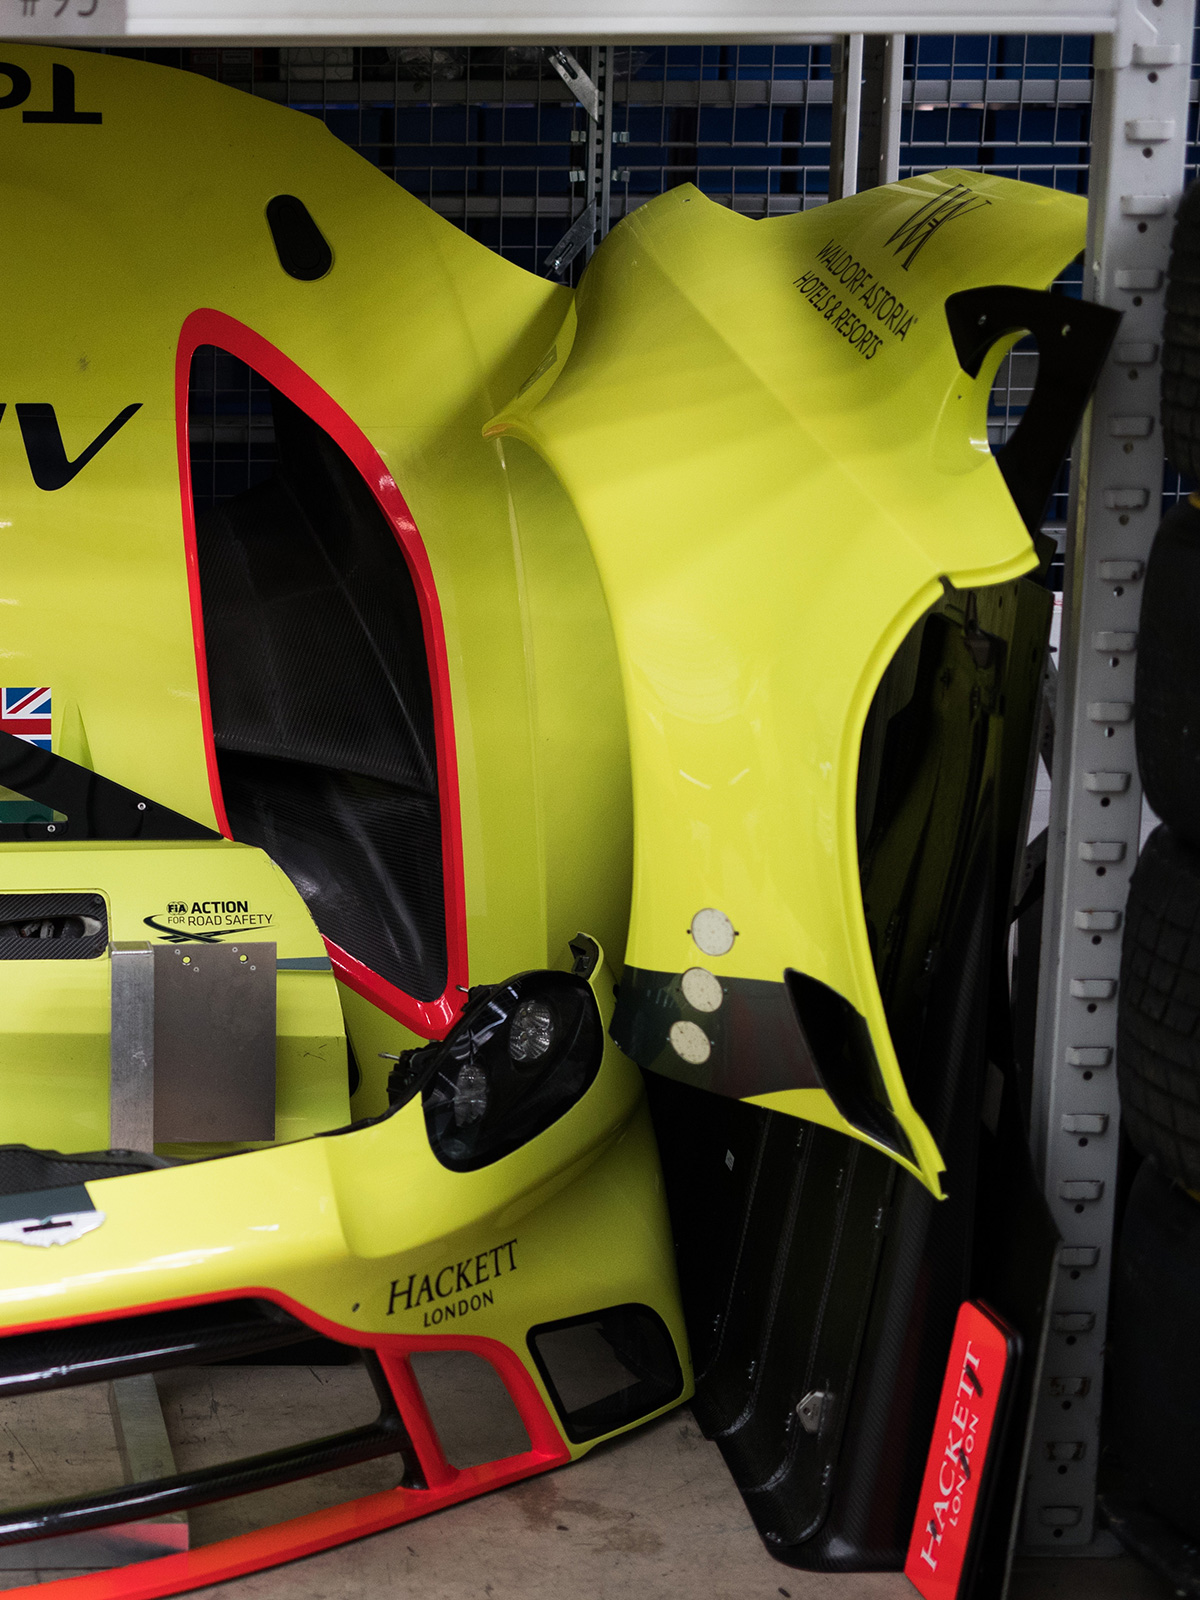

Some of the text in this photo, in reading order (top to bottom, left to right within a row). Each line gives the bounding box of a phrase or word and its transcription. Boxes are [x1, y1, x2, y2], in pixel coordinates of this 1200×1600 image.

[815, 238, 873, 294] WALDORF
[793, 270, 883, 360] HOTELS & RESORTS
[167, 914, 273, 926] FOR ROAD SAFETY
[191, 900, 248, 914] ACTION
[386, 1238, 518, 1316] HACKETT
[423, 1289, 494, 1328] LONDON
[920, 1340, 981, 1572] HACKETT
